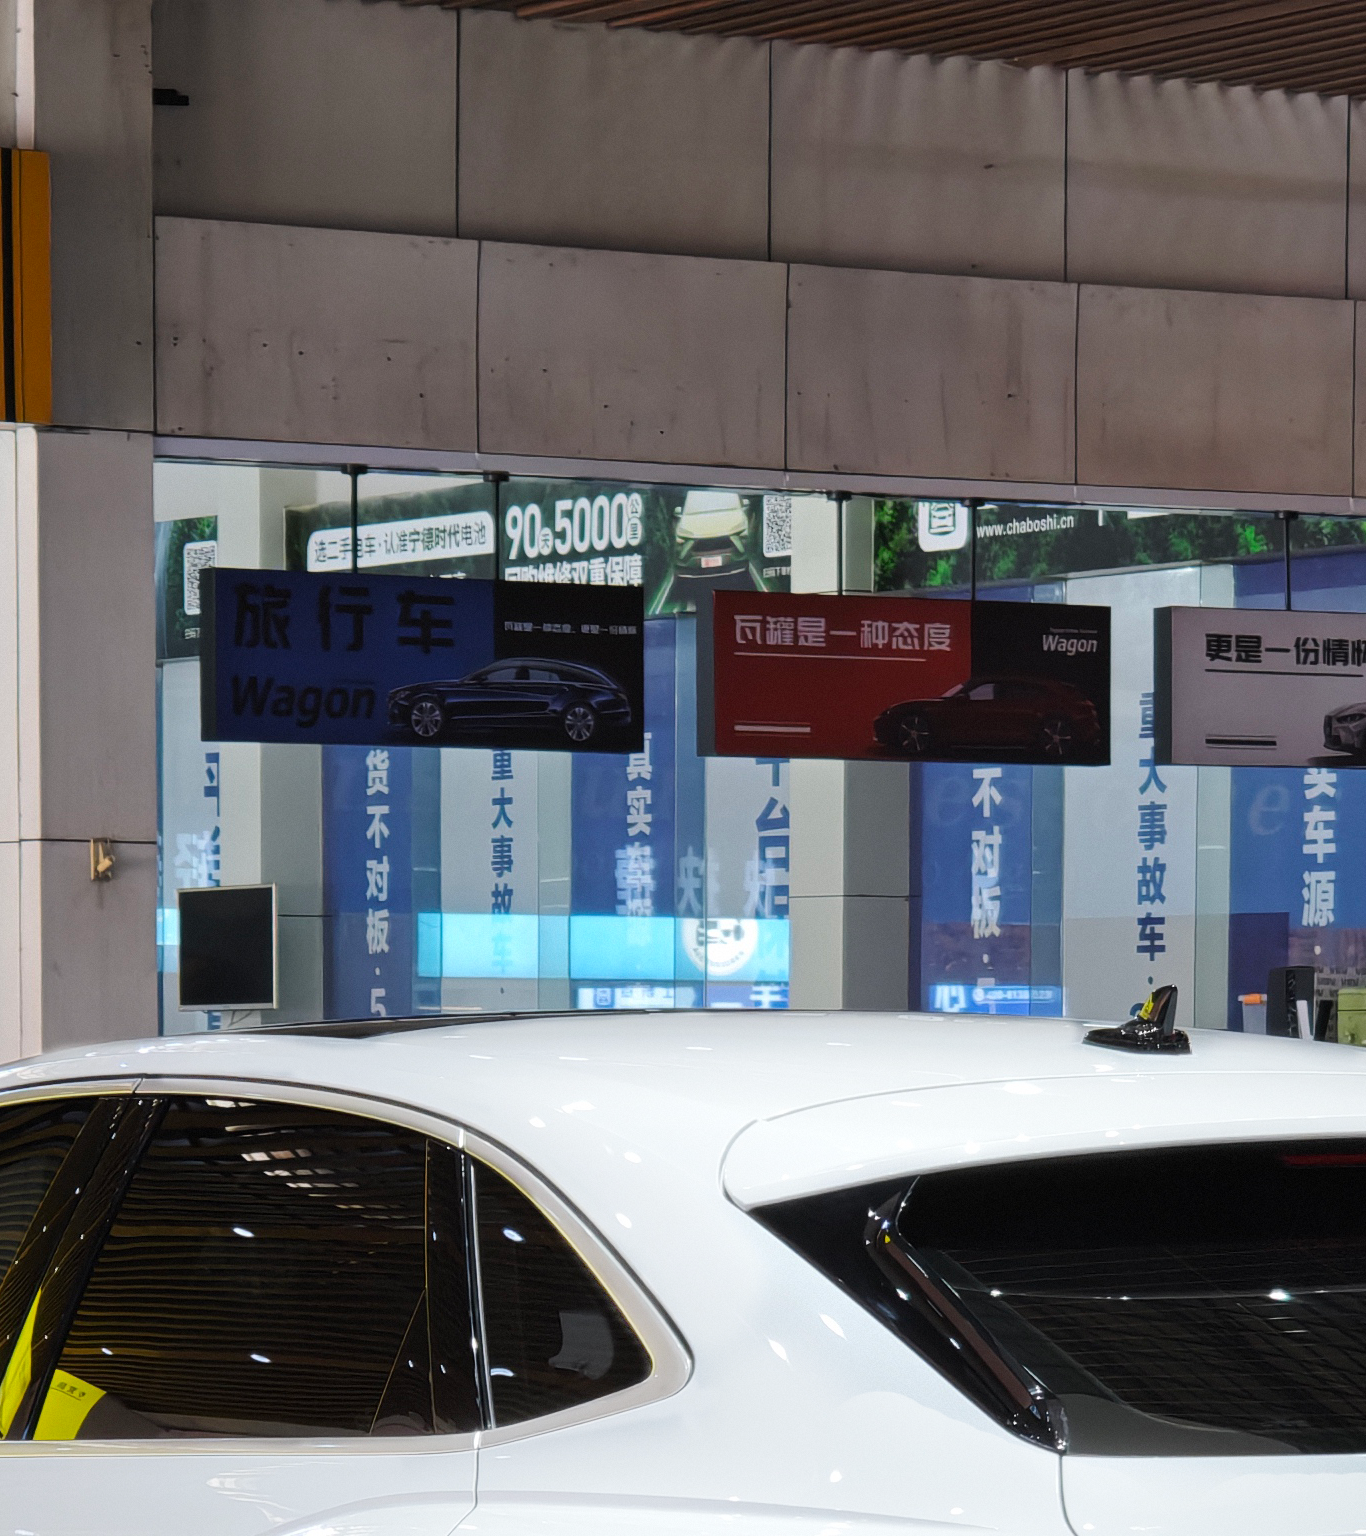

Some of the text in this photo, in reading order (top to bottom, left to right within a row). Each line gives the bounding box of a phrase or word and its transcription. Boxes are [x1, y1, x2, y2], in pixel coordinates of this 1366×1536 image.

[976, 513, 1075, 539] www.chaboshi.cn
[233, 583, 456, 655] 旅行车
[733, 614, 952, 652] 瓦罐是一种态度
[1042, 634, 1098, 656] Wagon
[231, 675, 375, 728] Wagon
